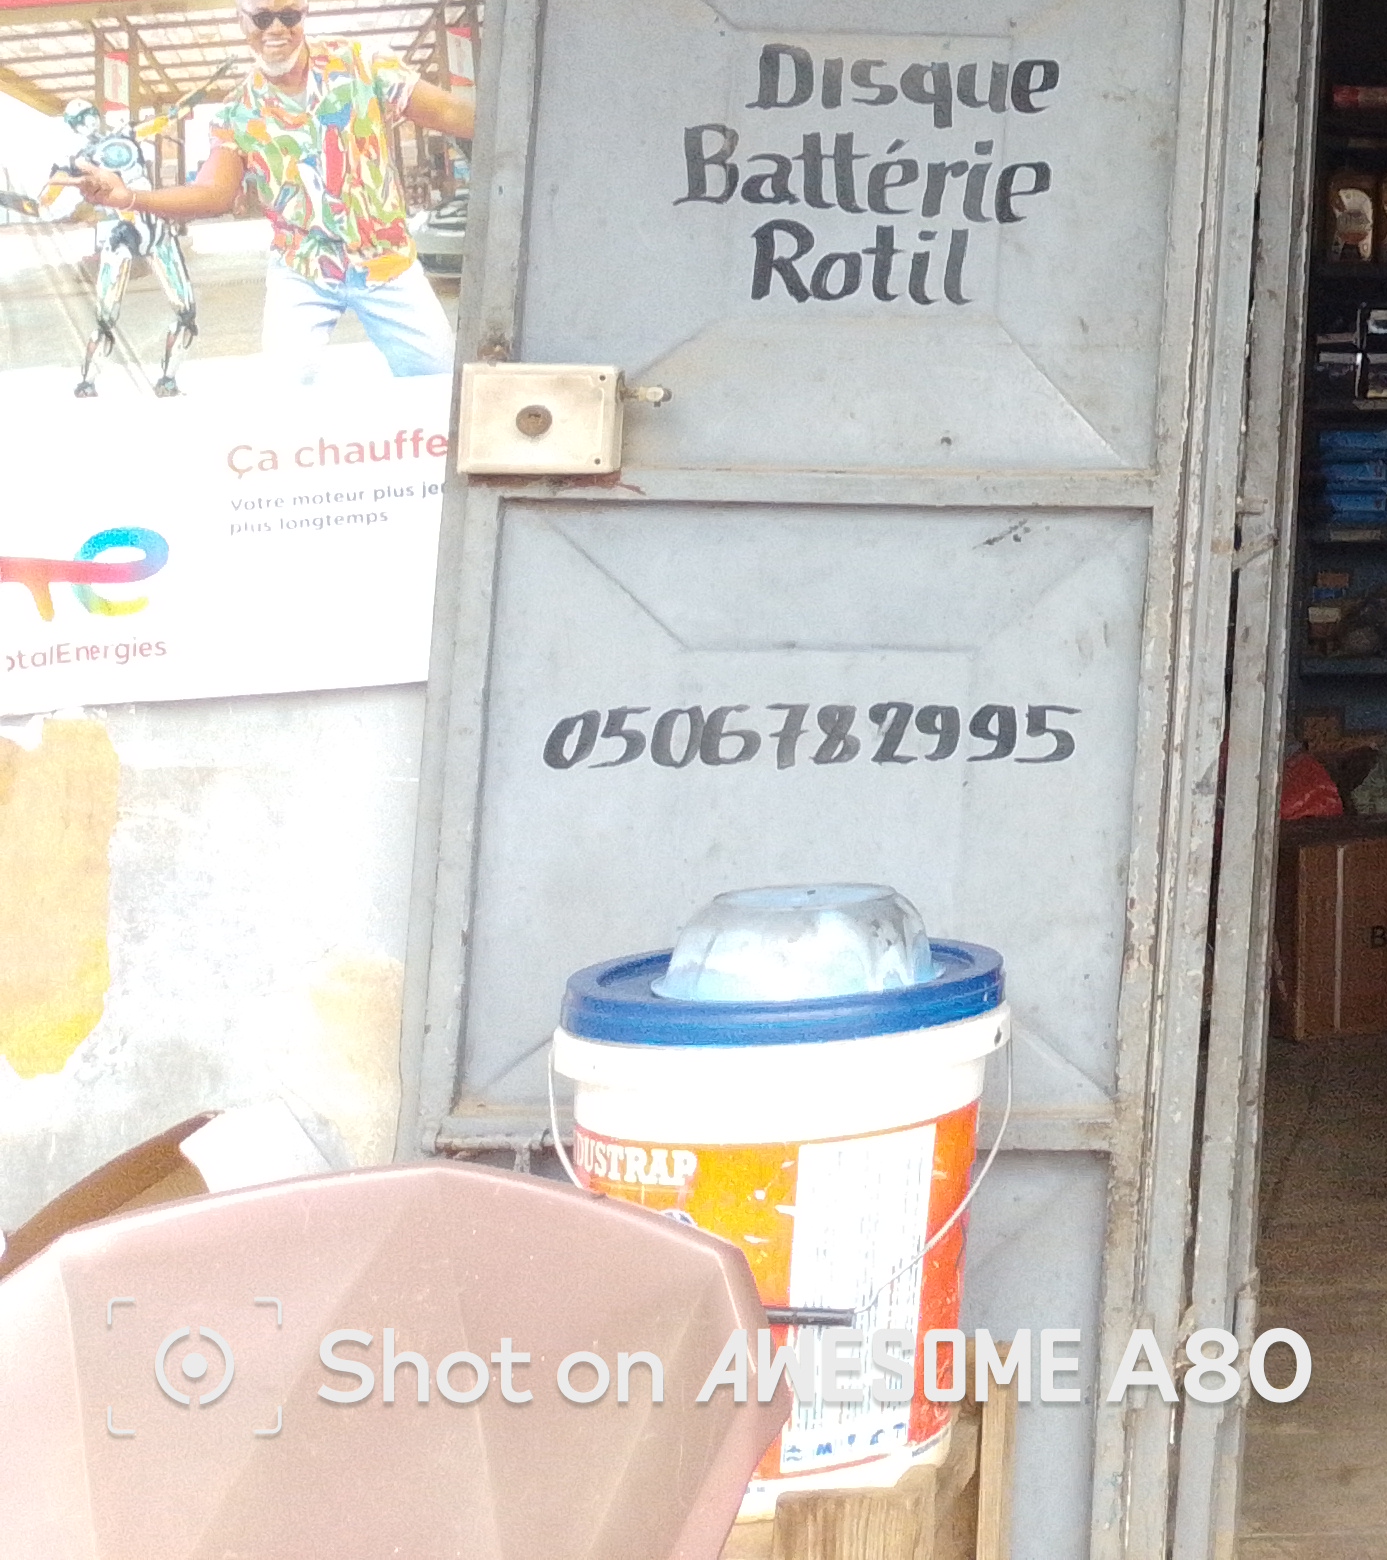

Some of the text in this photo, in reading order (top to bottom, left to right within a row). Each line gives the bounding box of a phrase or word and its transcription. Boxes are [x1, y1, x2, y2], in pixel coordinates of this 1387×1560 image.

[745, 43, 1060, 128] Disque
[673, 123, 1053, 225] Battérie
[750, 218, 975, 305] Rotil
[227, 428, 450, 479] Ça chauffe
[230, 511, 389, 537] plus longtemps
[231, 496, 285, 512] Votre
[293, 490, 365, 507] moteur
[373, 484, 415, 503] plus
[542, 701, 1083, 772] 0506782995
